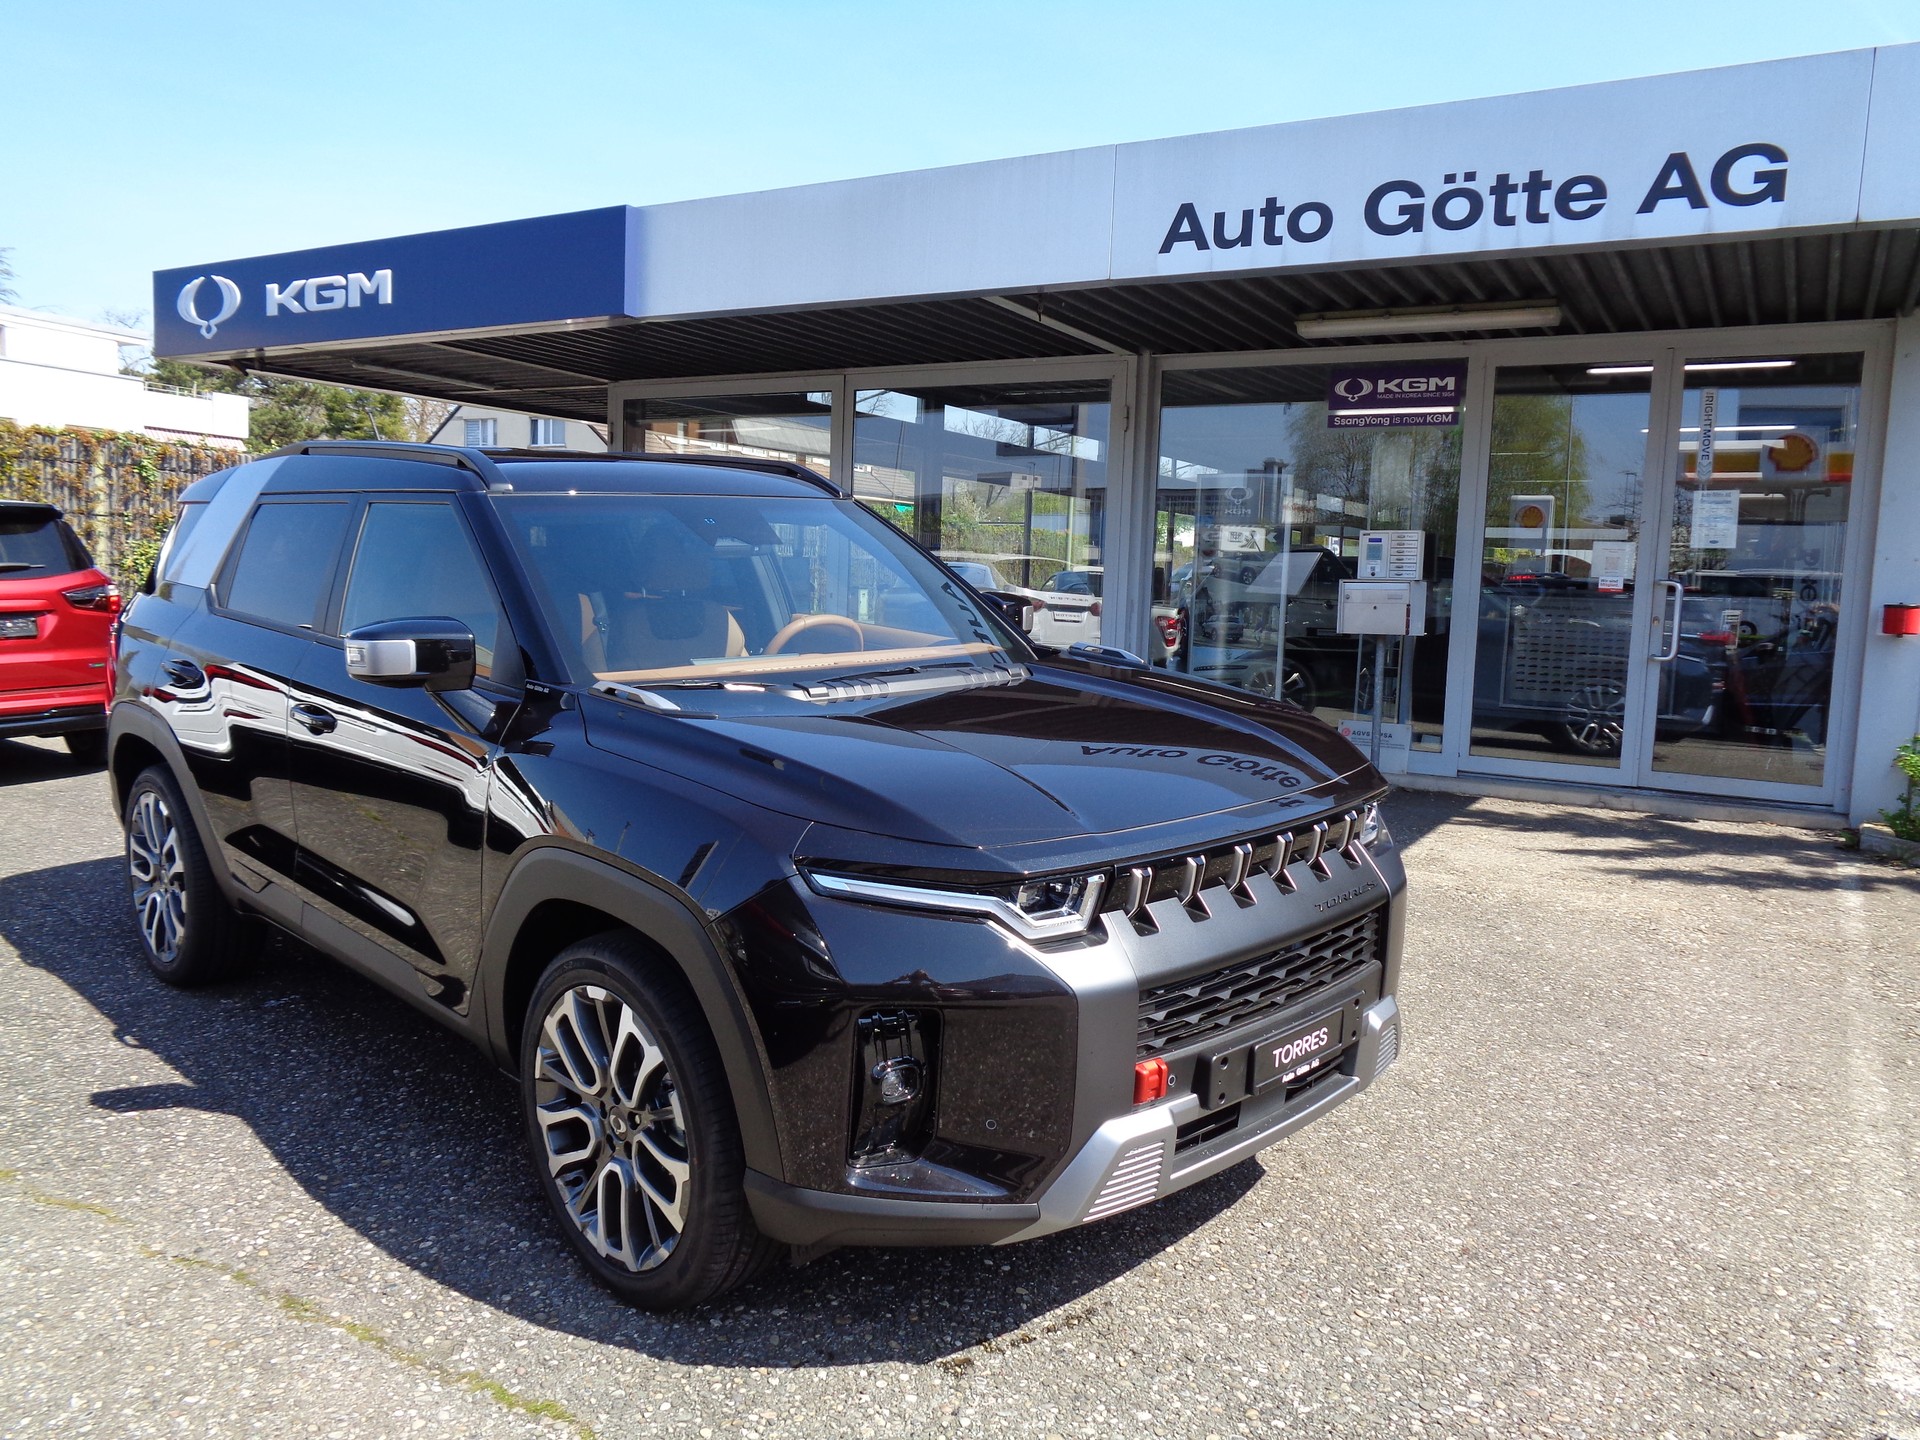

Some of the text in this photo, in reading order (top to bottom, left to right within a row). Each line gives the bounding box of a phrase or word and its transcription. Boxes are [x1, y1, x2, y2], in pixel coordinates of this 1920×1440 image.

[1158, 142, 1789, 254] Auto Götte AG
[265, 268, 393, 317] KGM
[1377, 376, 1456, 393] KGM
[1334, 414, 1452, 427] SsangYong is now KGM
[1314, 881, 1378, 912] TORRES
[1272, 1027, 1328, 1068] TORRES
